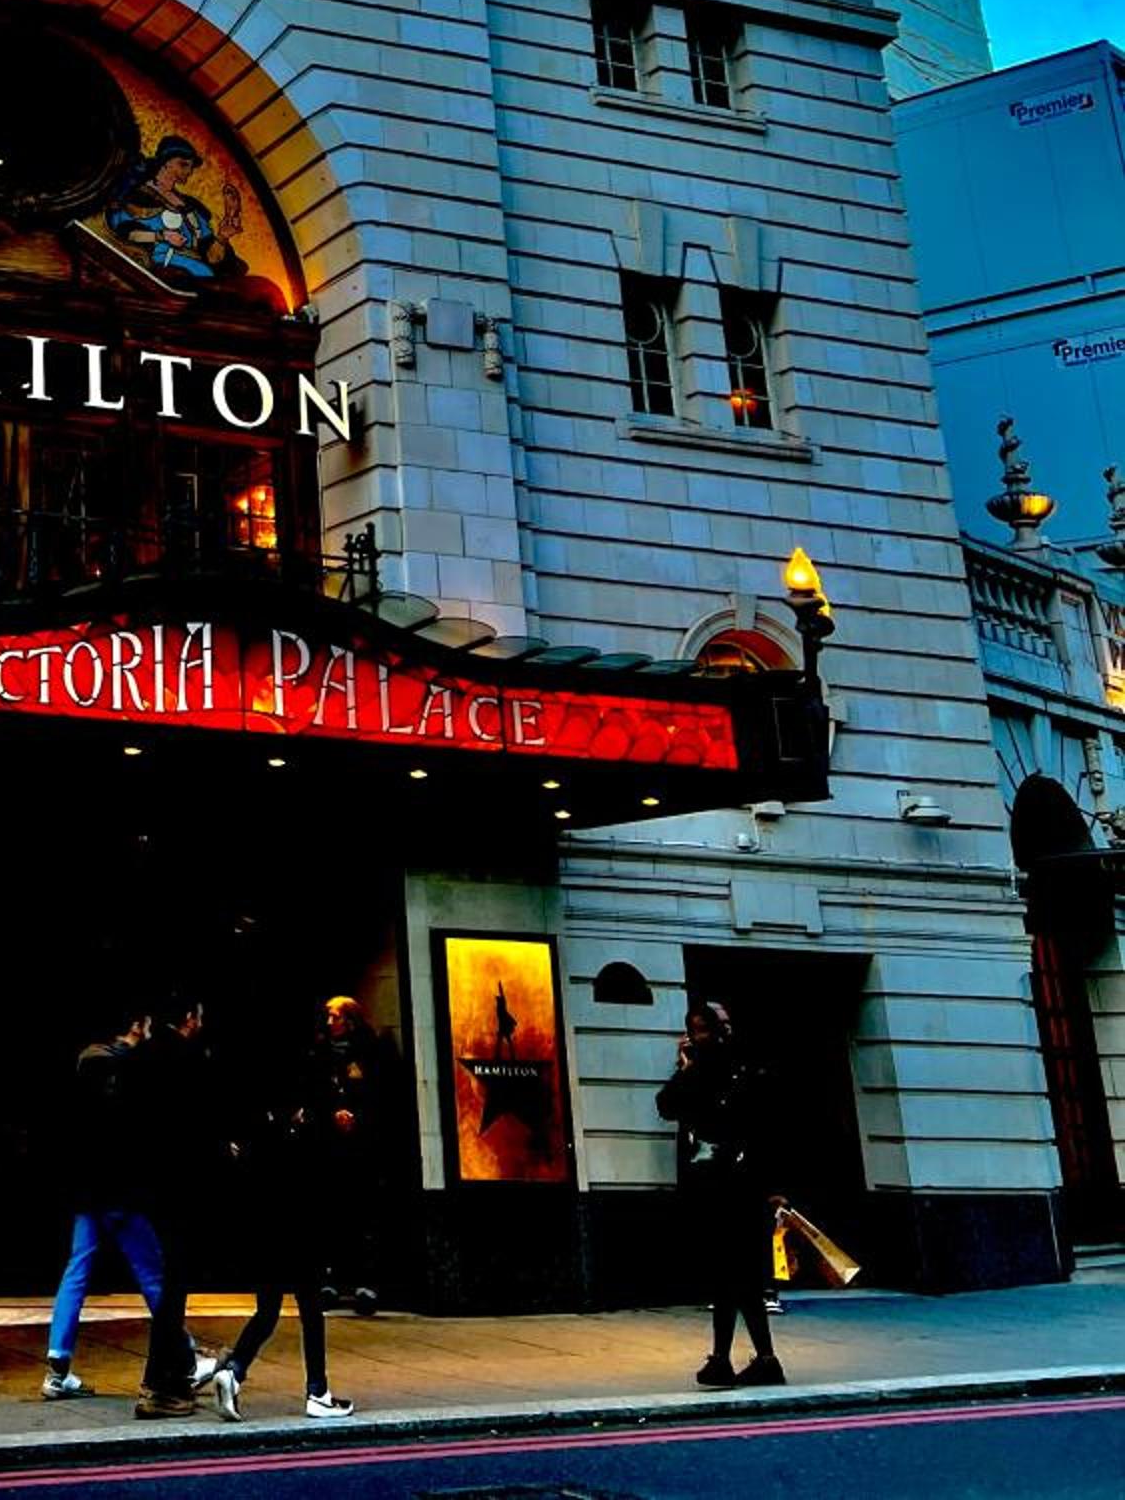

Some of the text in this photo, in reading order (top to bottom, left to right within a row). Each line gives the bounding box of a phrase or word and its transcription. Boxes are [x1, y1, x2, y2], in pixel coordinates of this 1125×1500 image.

[1016, 92, 1086, 120] Premier
[1062, 336, 1125, 361] Premie
[271, 628, 548, 747] PALACE
[474, 1065, 539, 1077] HAMILTON
